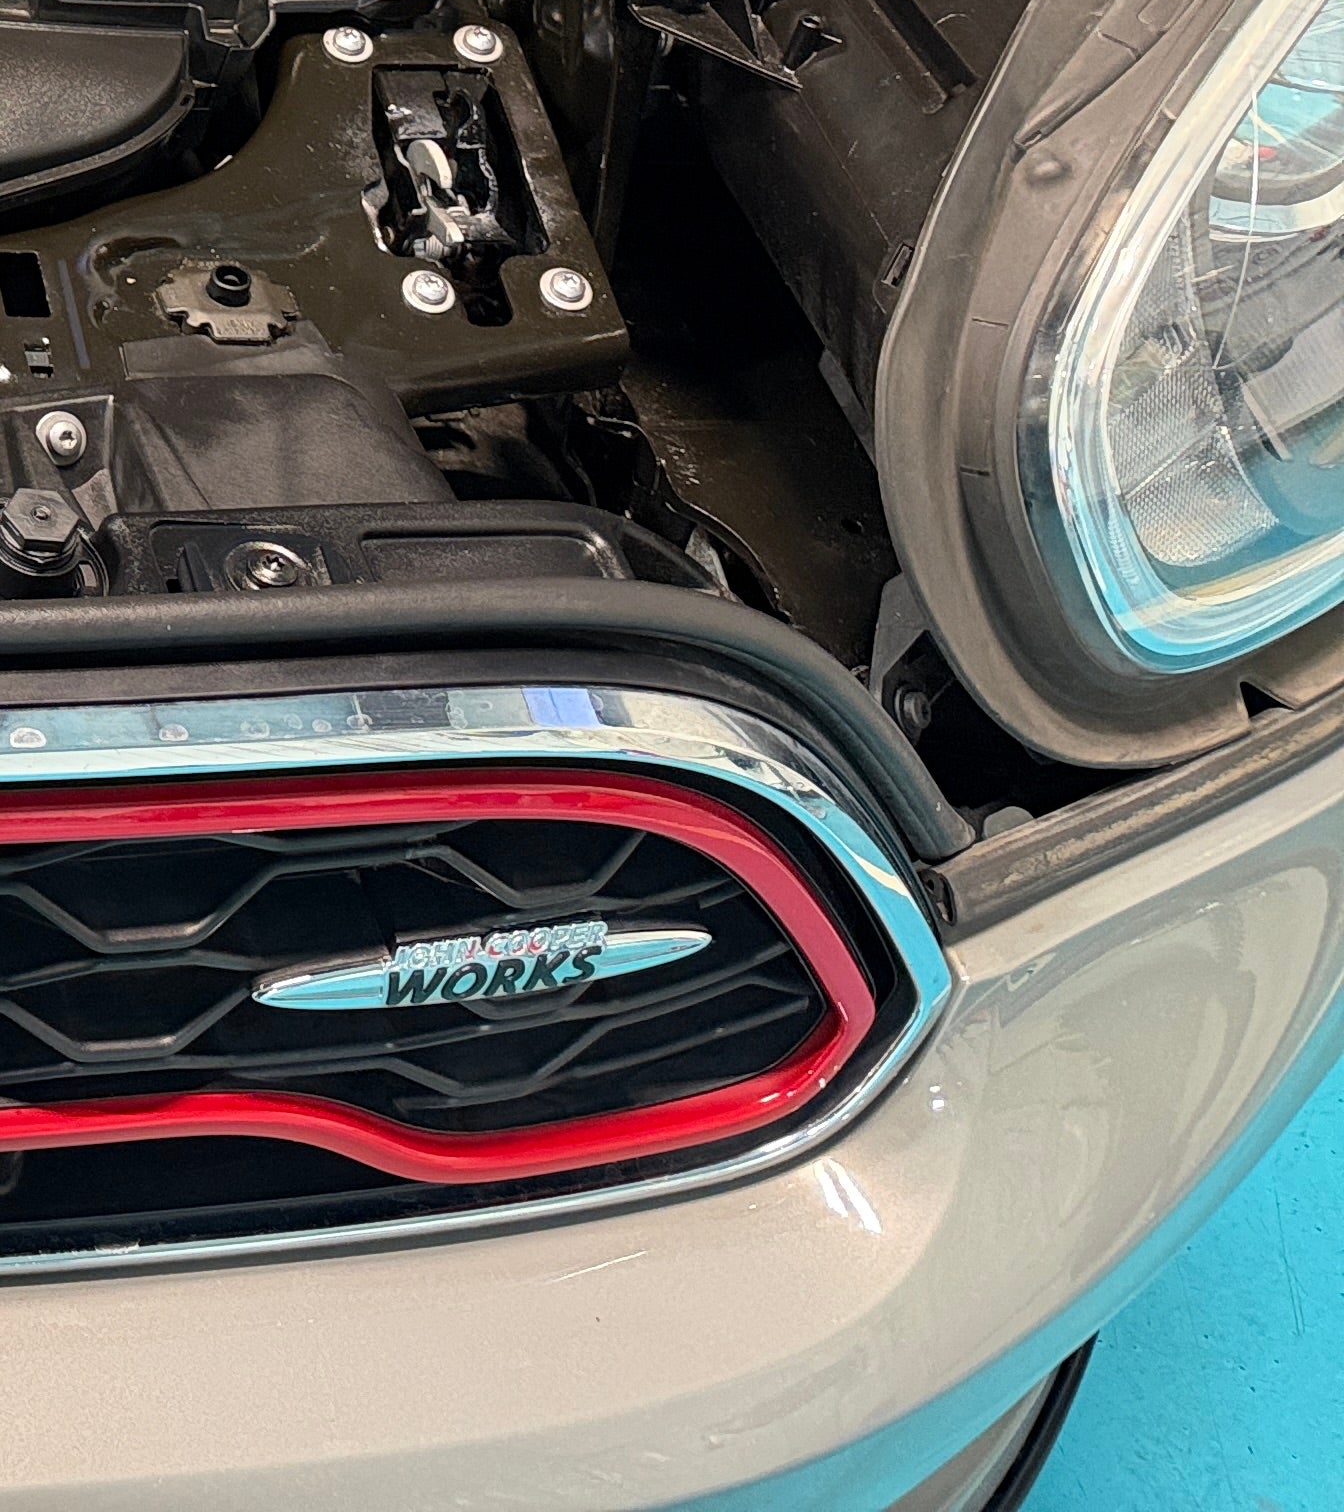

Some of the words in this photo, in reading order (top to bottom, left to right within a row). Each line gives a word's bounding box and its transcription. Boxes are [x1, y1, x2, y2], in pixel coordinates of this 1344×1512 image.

[387, 936, 482, 970] JOHN
[485, 921, 609, 958] COOPER
[385, 944, 604, 1006] WORKS
